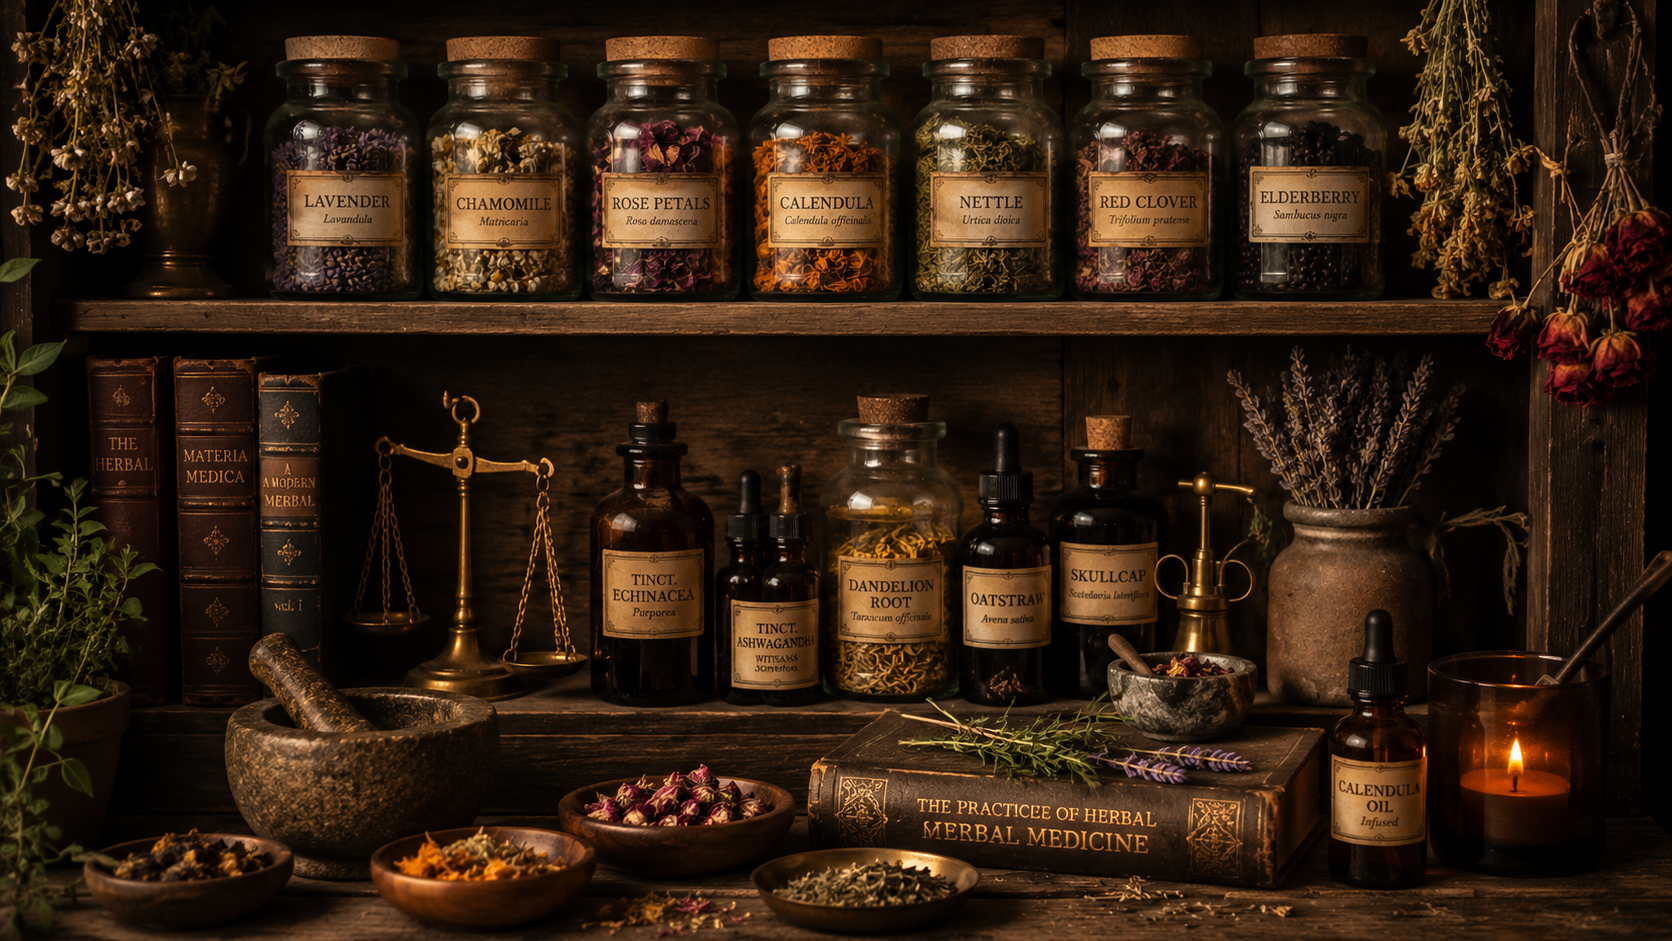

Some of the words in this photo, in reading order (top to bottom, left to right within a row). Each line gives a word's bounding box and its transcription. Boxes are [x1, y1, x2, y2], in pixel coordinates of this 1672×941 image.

[304, 194, 390, 208] LAVENDER
[612, 197, 649, 210] ROSE
[654, 197, 711, 210] PETALS
[780, 196, 874, 210] CALENDULA
[959, 195, 1024, 209] NETTLE
[1099, 196, 1131, 208] RED
[1135, 196, 1198, 208] CLOVER
[1260, 190, 1361, 204] ELDERBERRY
[456, 197, 552, 211] CHAMOMILE
[323, 213, 373, 224] Lavandula
[479, 216, 528, 226] Matricaria
[626, 216, 647, 226] Rosa
[650, 216, 698, 226] damascena
[785, 215, 828, 225] Calendula
[962, 215, 991, 225] Urtica
[993, 215, 1020, 225] dioica
[1109, 214, 1151, 226] Trifolium
[1273, 209, 1322, 220] Sambucus
[1323, 210, 1348, 223] nigra
[108, 437, 138, 450] THE
[183, 449, 248, 462] MATERIA
[95, 458, 153, 472] HERBAL
[186, 470, 245, 484] MEDICA
[631, 574, 678, 586] TINCT.
[1071, 568, 1147, 582] SKULLCAP
[848, 579, 934, 592] DANDELION
[612, 588, 694, 602] ECHINACEA
[971, 592, 1045, 606] OATSTRAW
[870, 596, 912, 608] ROOT
[981, 614, 1008, 624] Avena
[1010, 614, 1034, 624] sativa
[756, 622, 798, 634] TINCT.
[1338, 780, 1421, 797] CALENDULA
[916, 798, 952, 814] THE
[1056, 806, 1079, 822] OF
[1083, 807, 1158, 828] HERBAL
[1366, 800, 1394, 813] OIL
[1360, 816, 1399, 830] Infused
[922, 820, 1020, 846] MERBAL
[1026, 826, 1149, 854] MEDICINE
